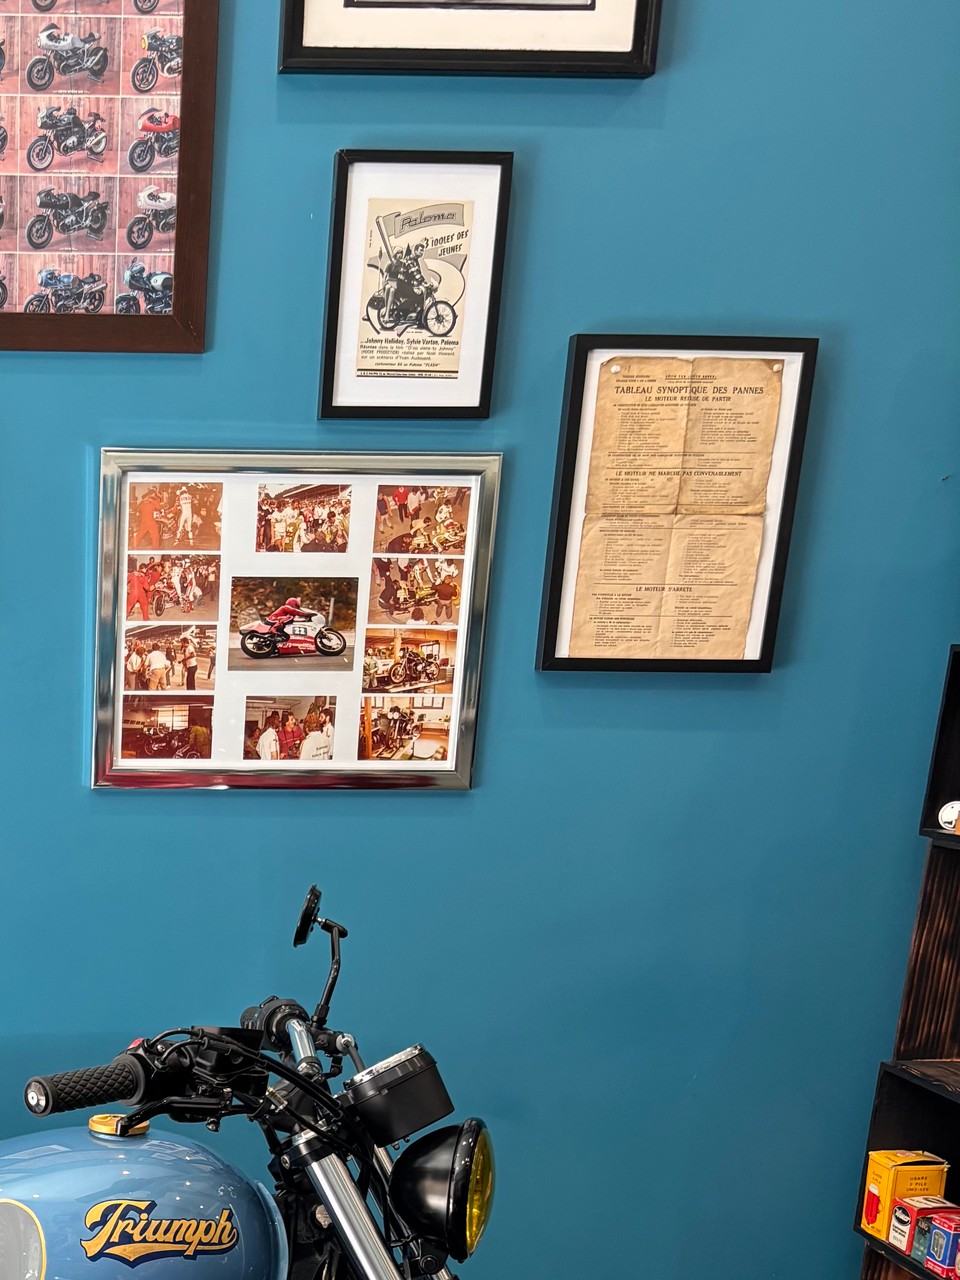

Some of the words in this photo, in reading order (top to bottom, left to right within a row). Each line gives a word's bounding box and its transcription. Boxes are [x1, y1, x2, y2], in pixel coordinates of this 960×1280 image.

[399, 210, 457, 233] Paloma
[431, 233, 455, 247] IDOLES
[456, 229, 470, 241] DES
[438, 243, 463, 257] JEUNES
[614, 386, 653, 395] TABLEAU
[656, 386, 708, 395] SYNOPTIQUE
[712, 386, 728, 395] DES
[732, 386, 764, 395] PANNES
[80, 1198, 240, 1268] Triumph
